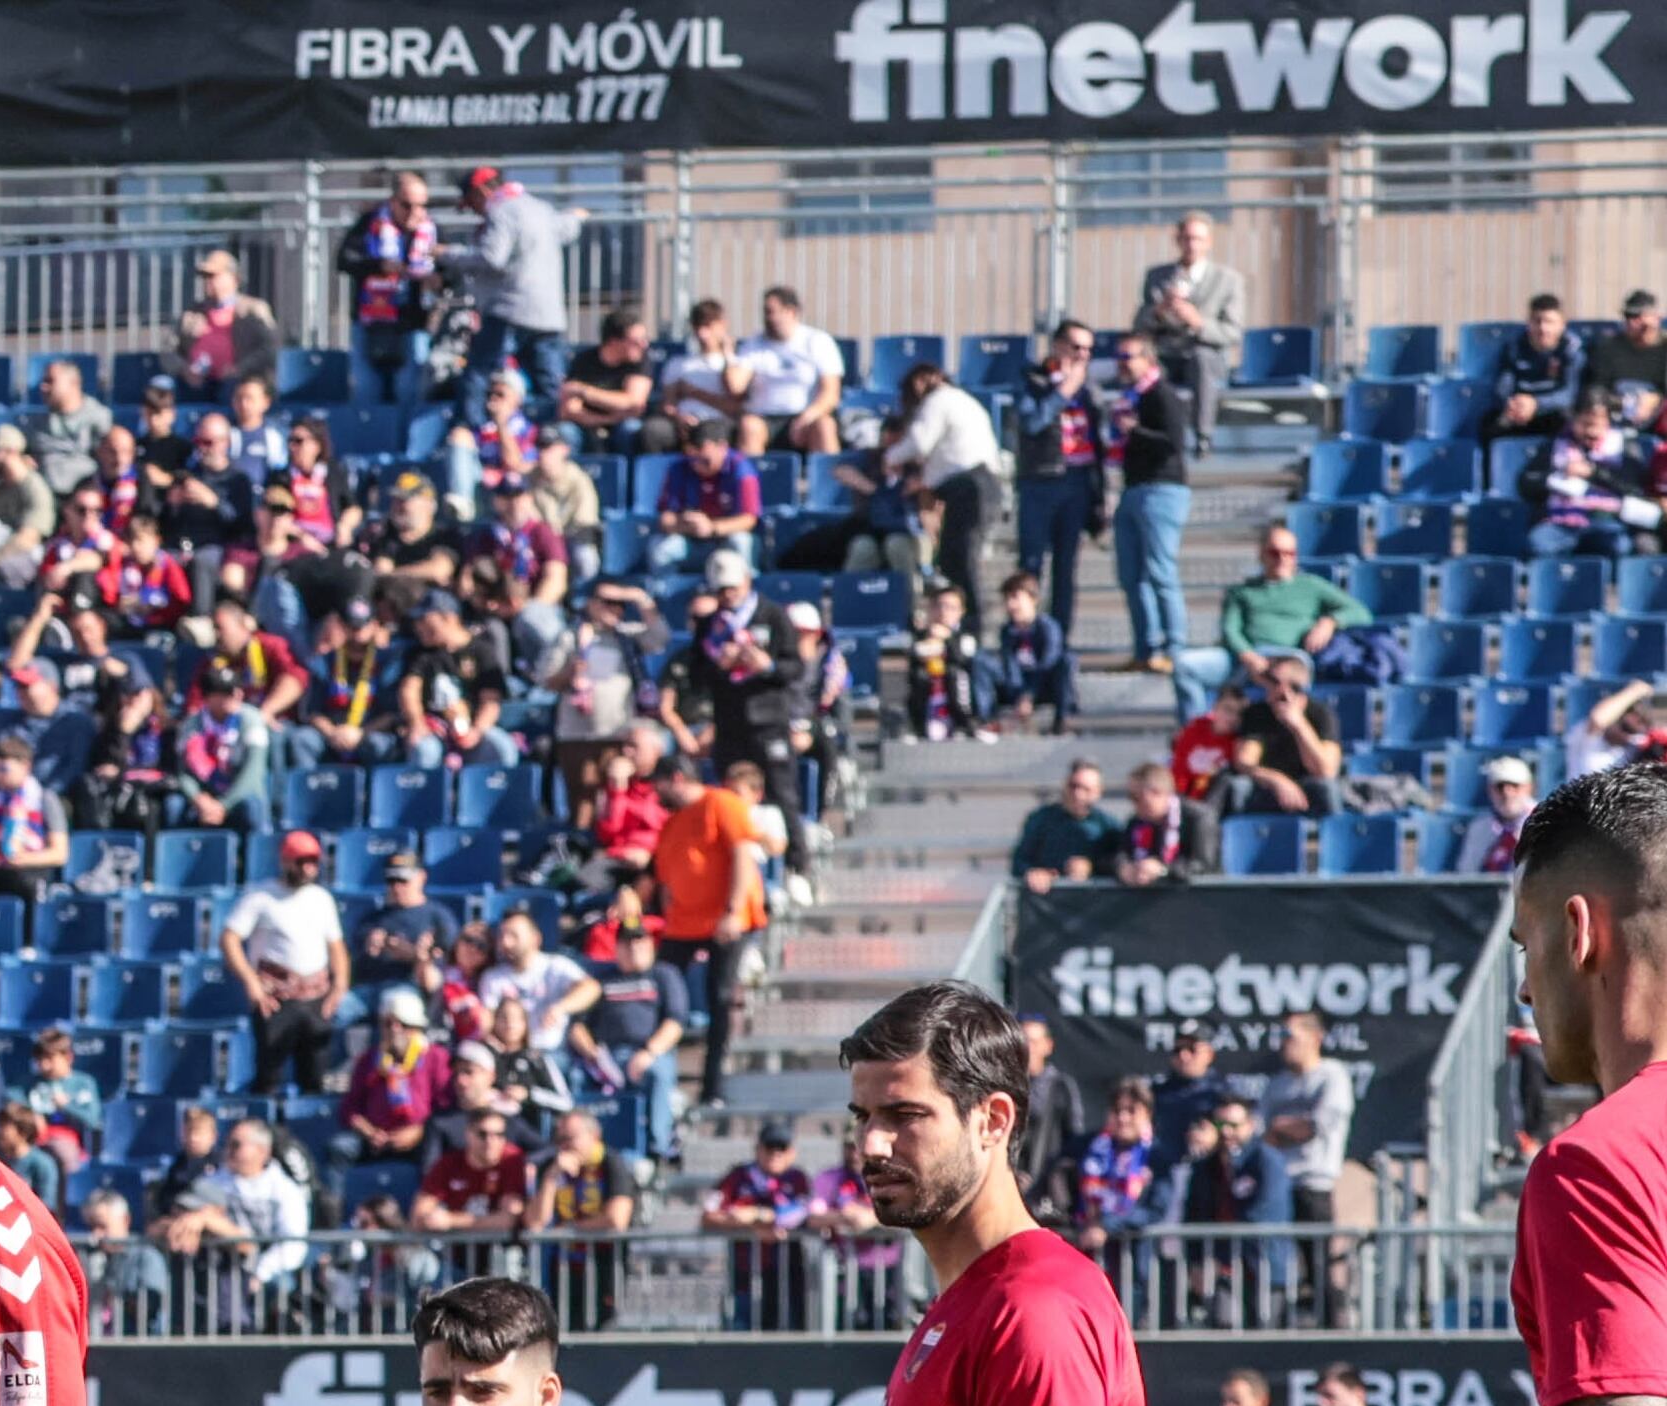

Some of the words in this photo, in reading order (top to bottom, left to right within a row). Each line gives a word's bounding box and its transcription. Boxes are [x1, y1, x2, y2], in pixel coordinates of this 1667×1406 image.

[295, 26, 480, 79] FIBRA
[488, 23, 537, 77] Y
[547, 8, 743, 74] MÓVIL
[835, 0, 1633, 123] finetwork
[575, 74, 669, 122] 1777
[1053, 943, 1464, 1018] finetwork
[1239, 1021, 1267, 1051] Y
[4, 1373, 41, 1388] ELDA
